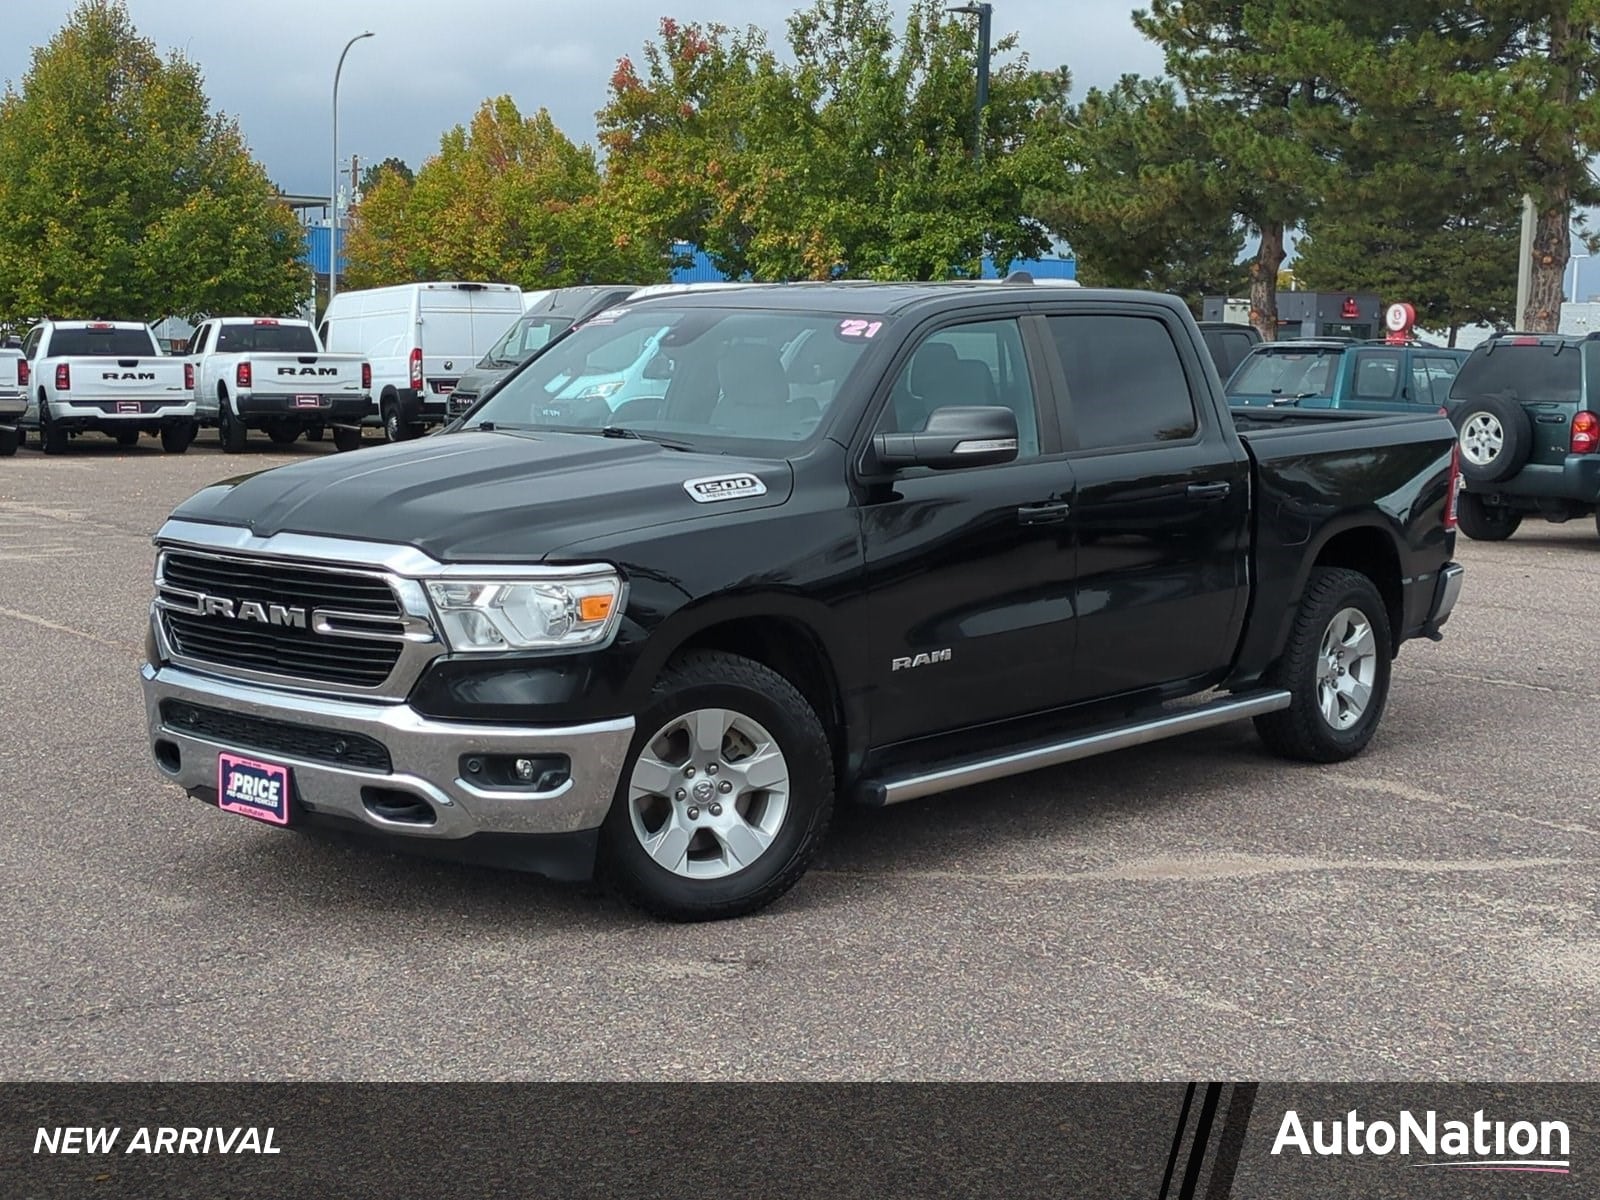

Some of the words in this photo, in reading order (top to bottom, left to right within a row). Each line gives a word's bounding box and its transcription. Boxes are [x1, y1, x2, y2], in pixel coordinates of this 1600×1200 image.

[102, 372, 155, 380] RAM
[277, 367, 337, 376] RAM
[696, 478, 752, 493] 1500
[205, 595, 306, 628] RAM
[892, 648, 952, 671] RAM
